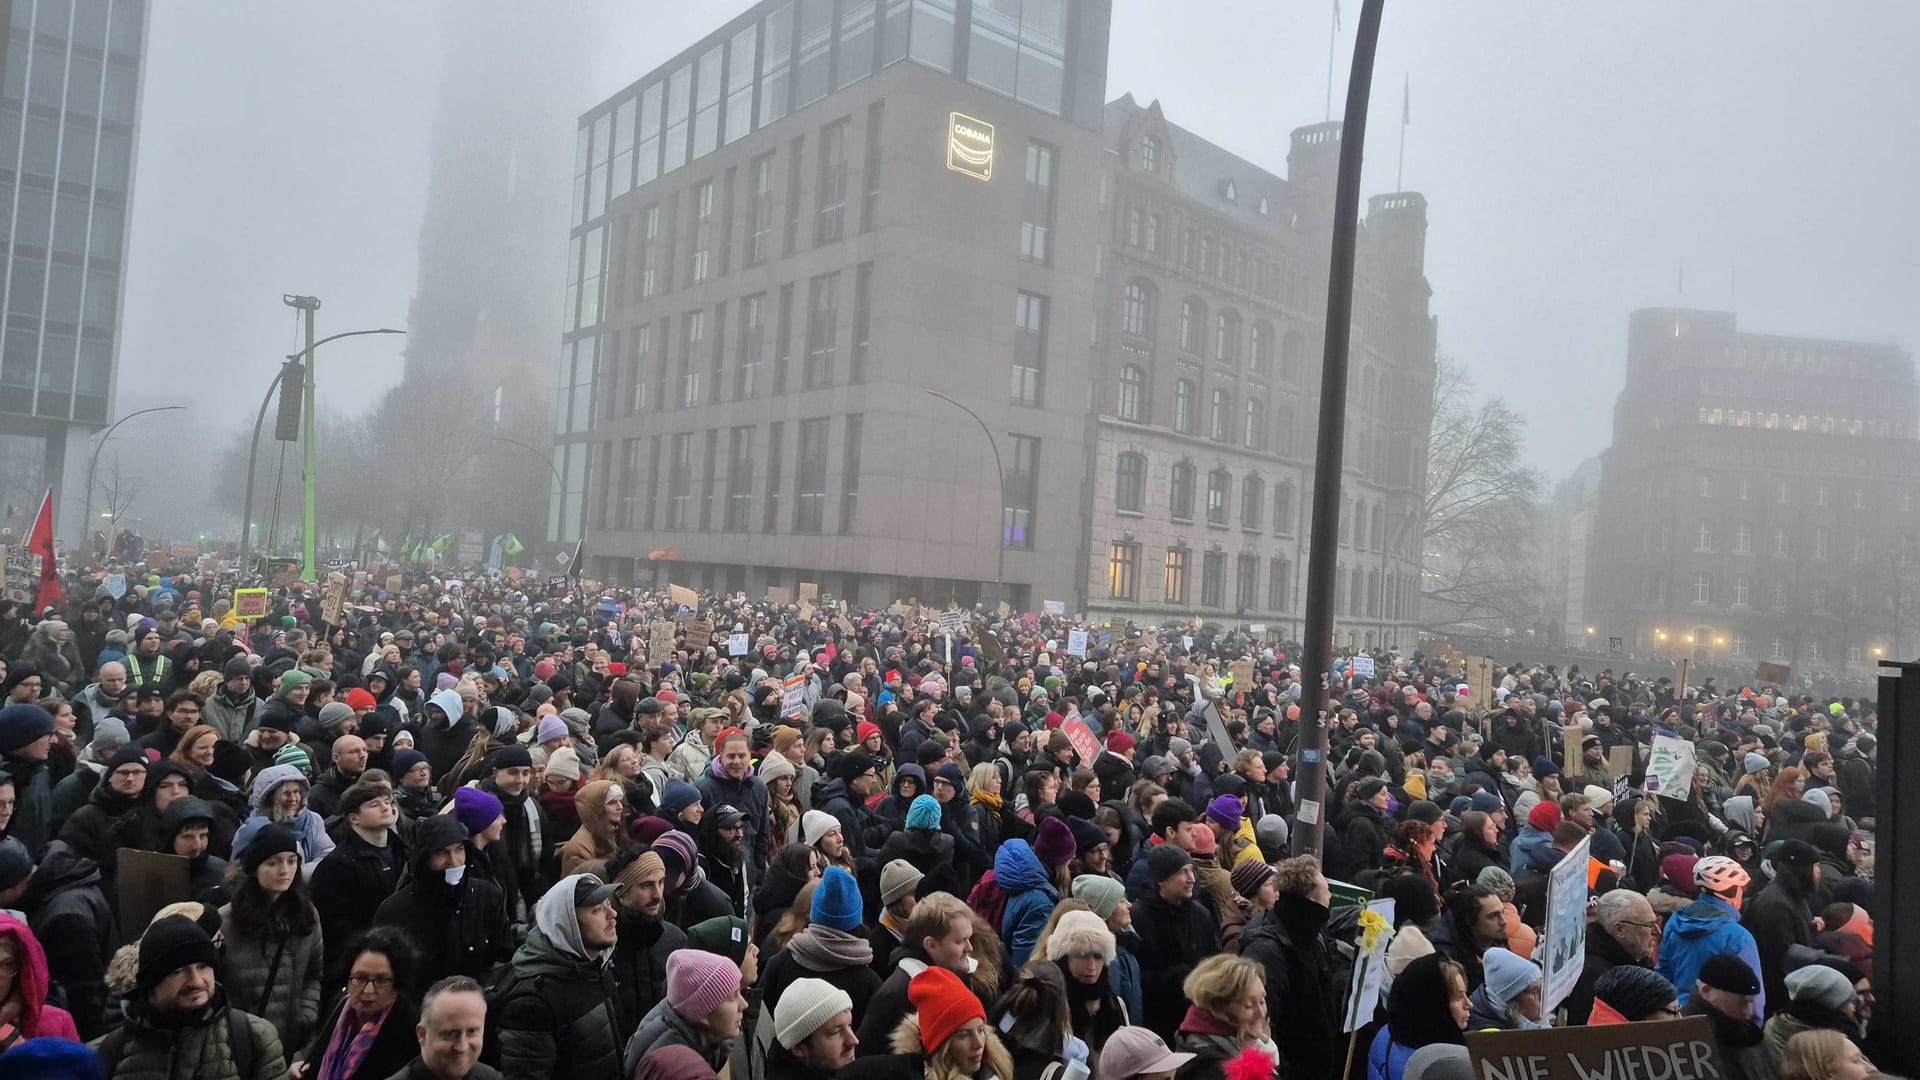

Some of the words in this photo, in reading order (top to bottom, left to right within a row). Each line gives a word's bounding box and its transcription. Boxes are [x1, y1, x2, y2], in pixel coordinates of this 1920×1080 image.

[955, 124, 990, 144] COBANA
[1480, 1056, 1549, 1080] NIE
[1567, 1041, 1720, 1080] WIEDER
